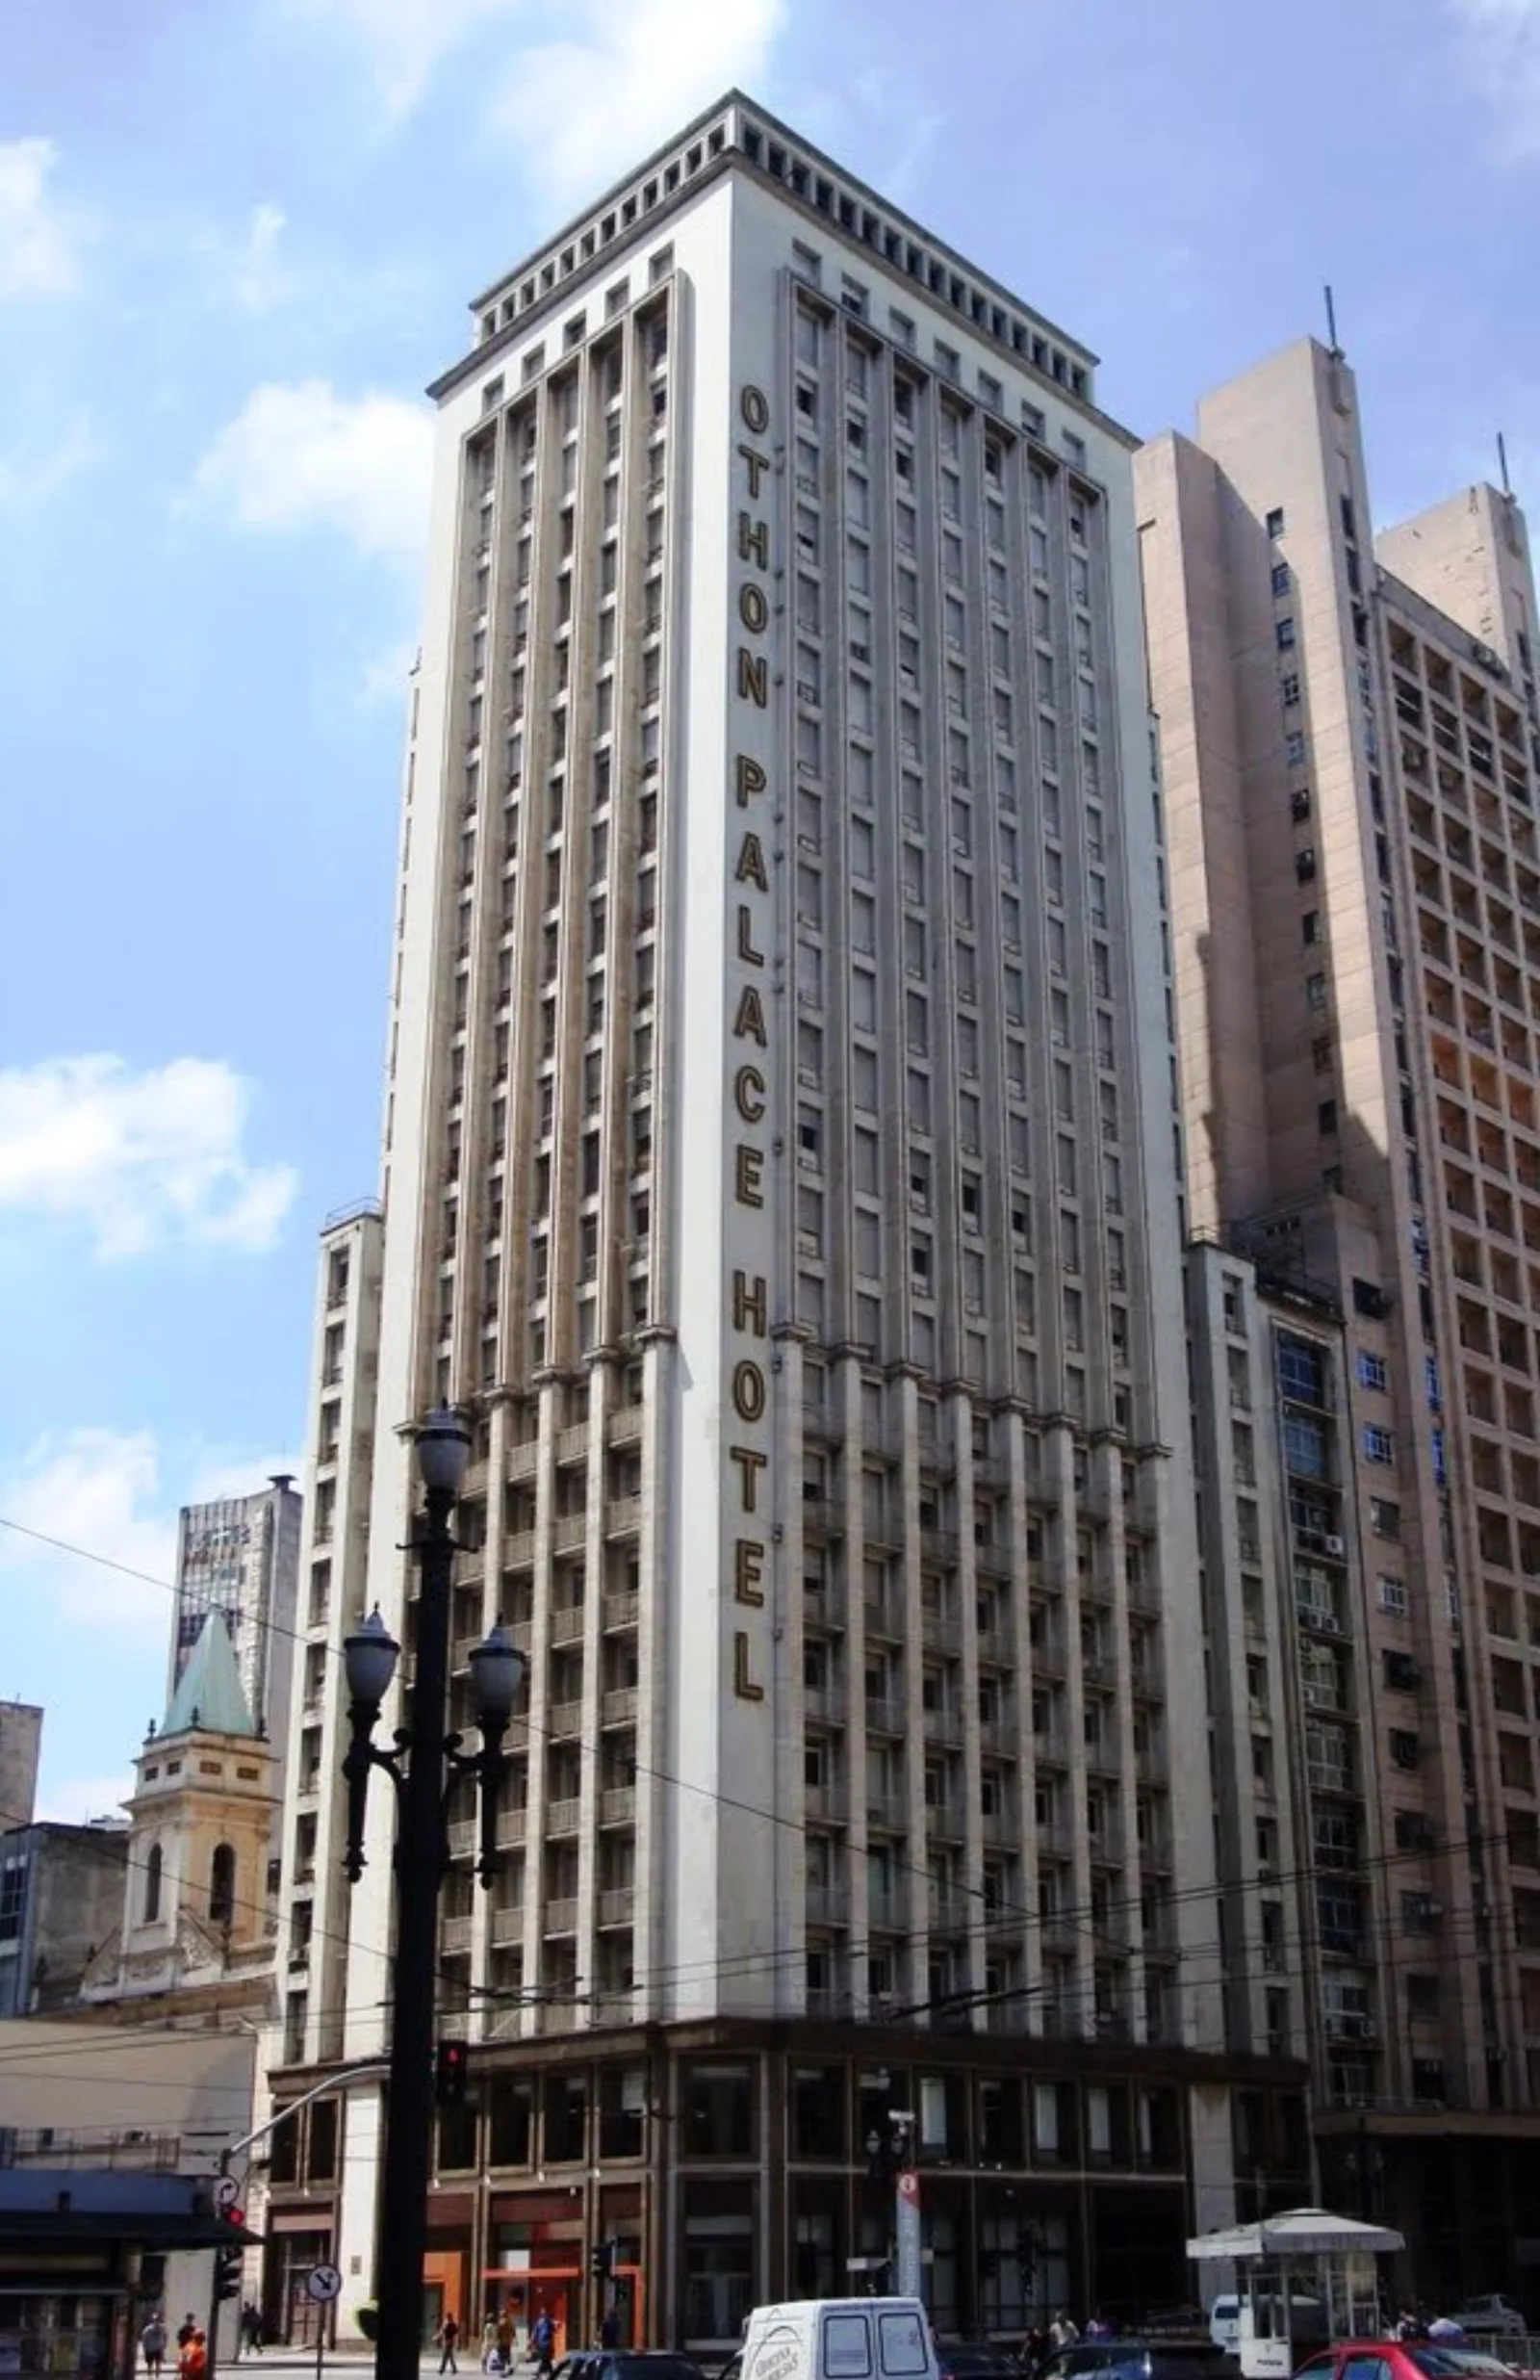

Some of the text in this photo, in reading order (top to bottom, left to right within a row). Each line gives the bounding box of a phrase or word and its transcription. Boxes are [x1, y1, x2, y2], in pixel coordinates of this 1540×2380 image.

[730, 384, 769, 1701] OTHON PALACE HOTEL
